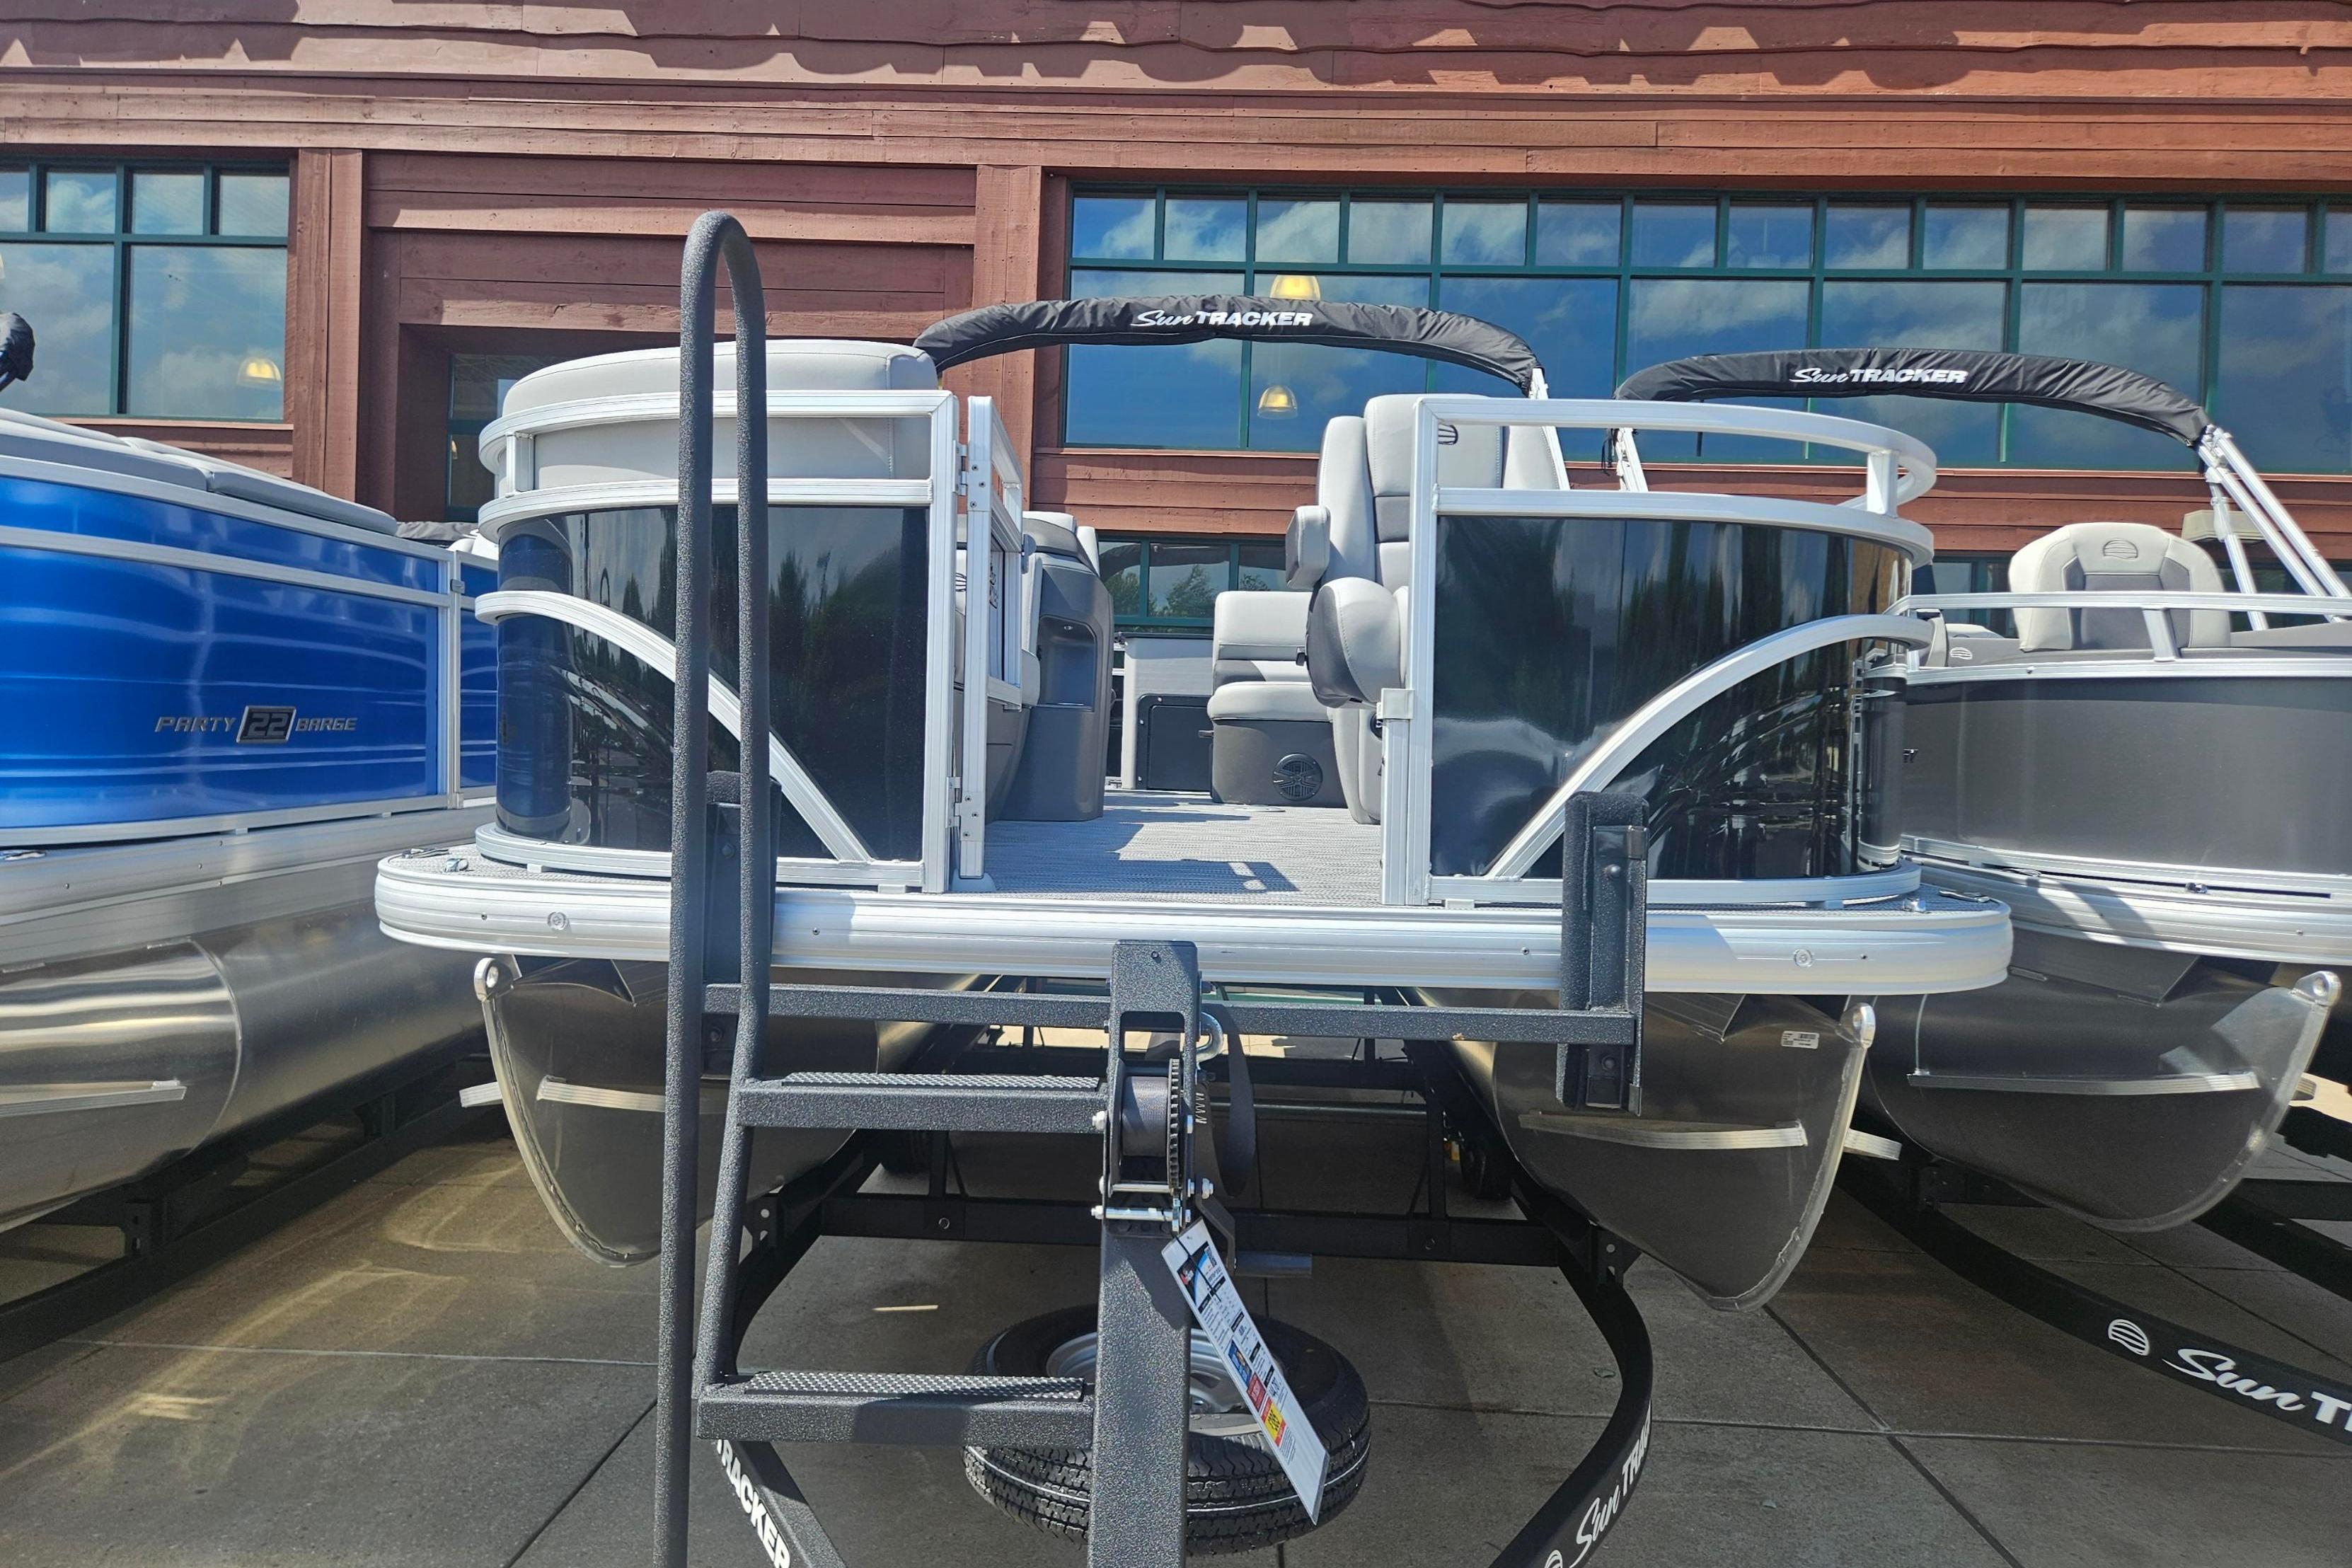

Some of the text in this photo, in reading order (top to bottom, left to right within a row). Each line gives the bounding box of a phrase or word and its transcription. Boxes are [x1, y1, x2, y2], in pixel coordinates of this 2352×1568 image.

[1130, 310, 1313, 327] Sun TRACKER
[1789, 368, 1968, 384] Sun TRACKER
[154, 712, 359, 737] PARTY 22 BARGE
[2162, 1348, 2306, 1412] Sun
[1568, 1485, 1620, 1568] Sun
